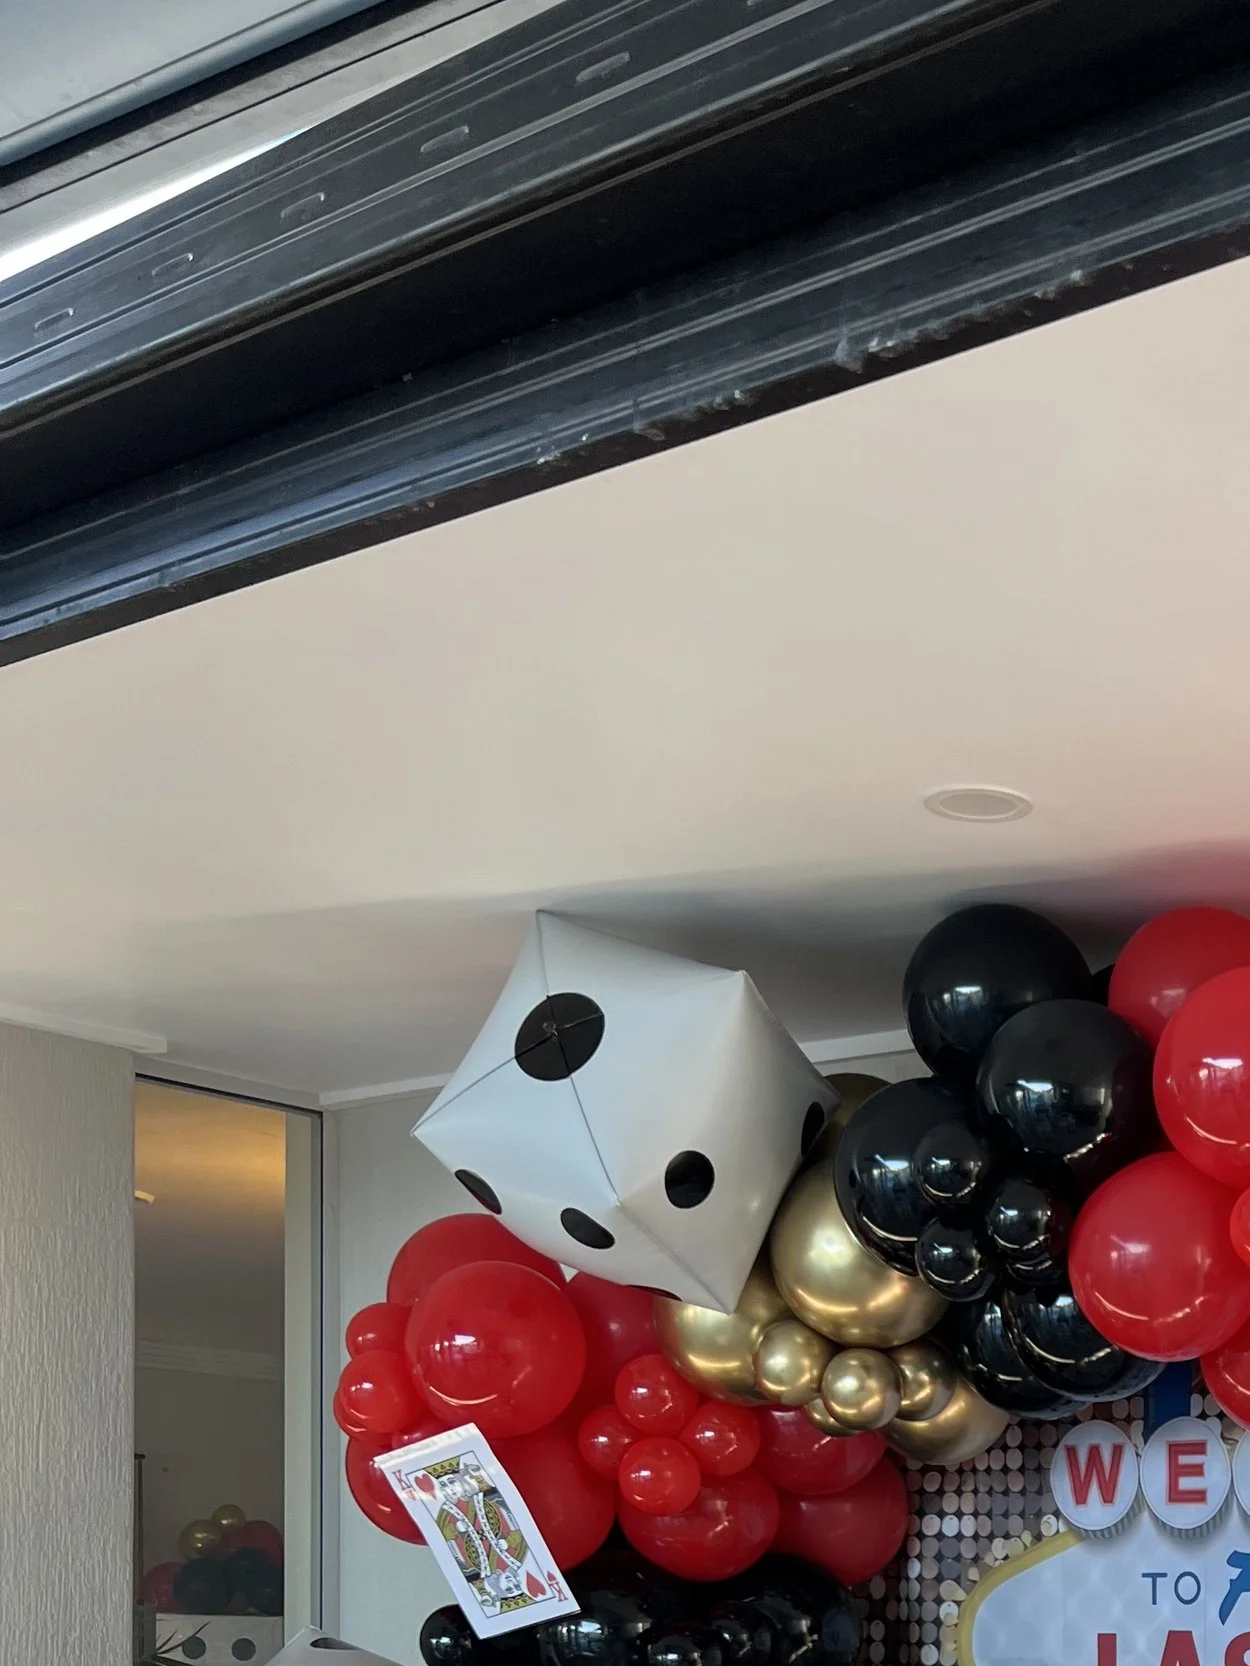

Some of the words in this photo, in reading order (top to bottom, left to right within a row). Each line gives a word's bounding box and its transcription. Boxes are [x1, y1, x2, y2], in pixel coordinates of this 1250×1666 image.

[392, 1469, 411, 1490] K
[549, 1581, 568, 1602] K
[1141, 1571, 1202, 1606] TO
